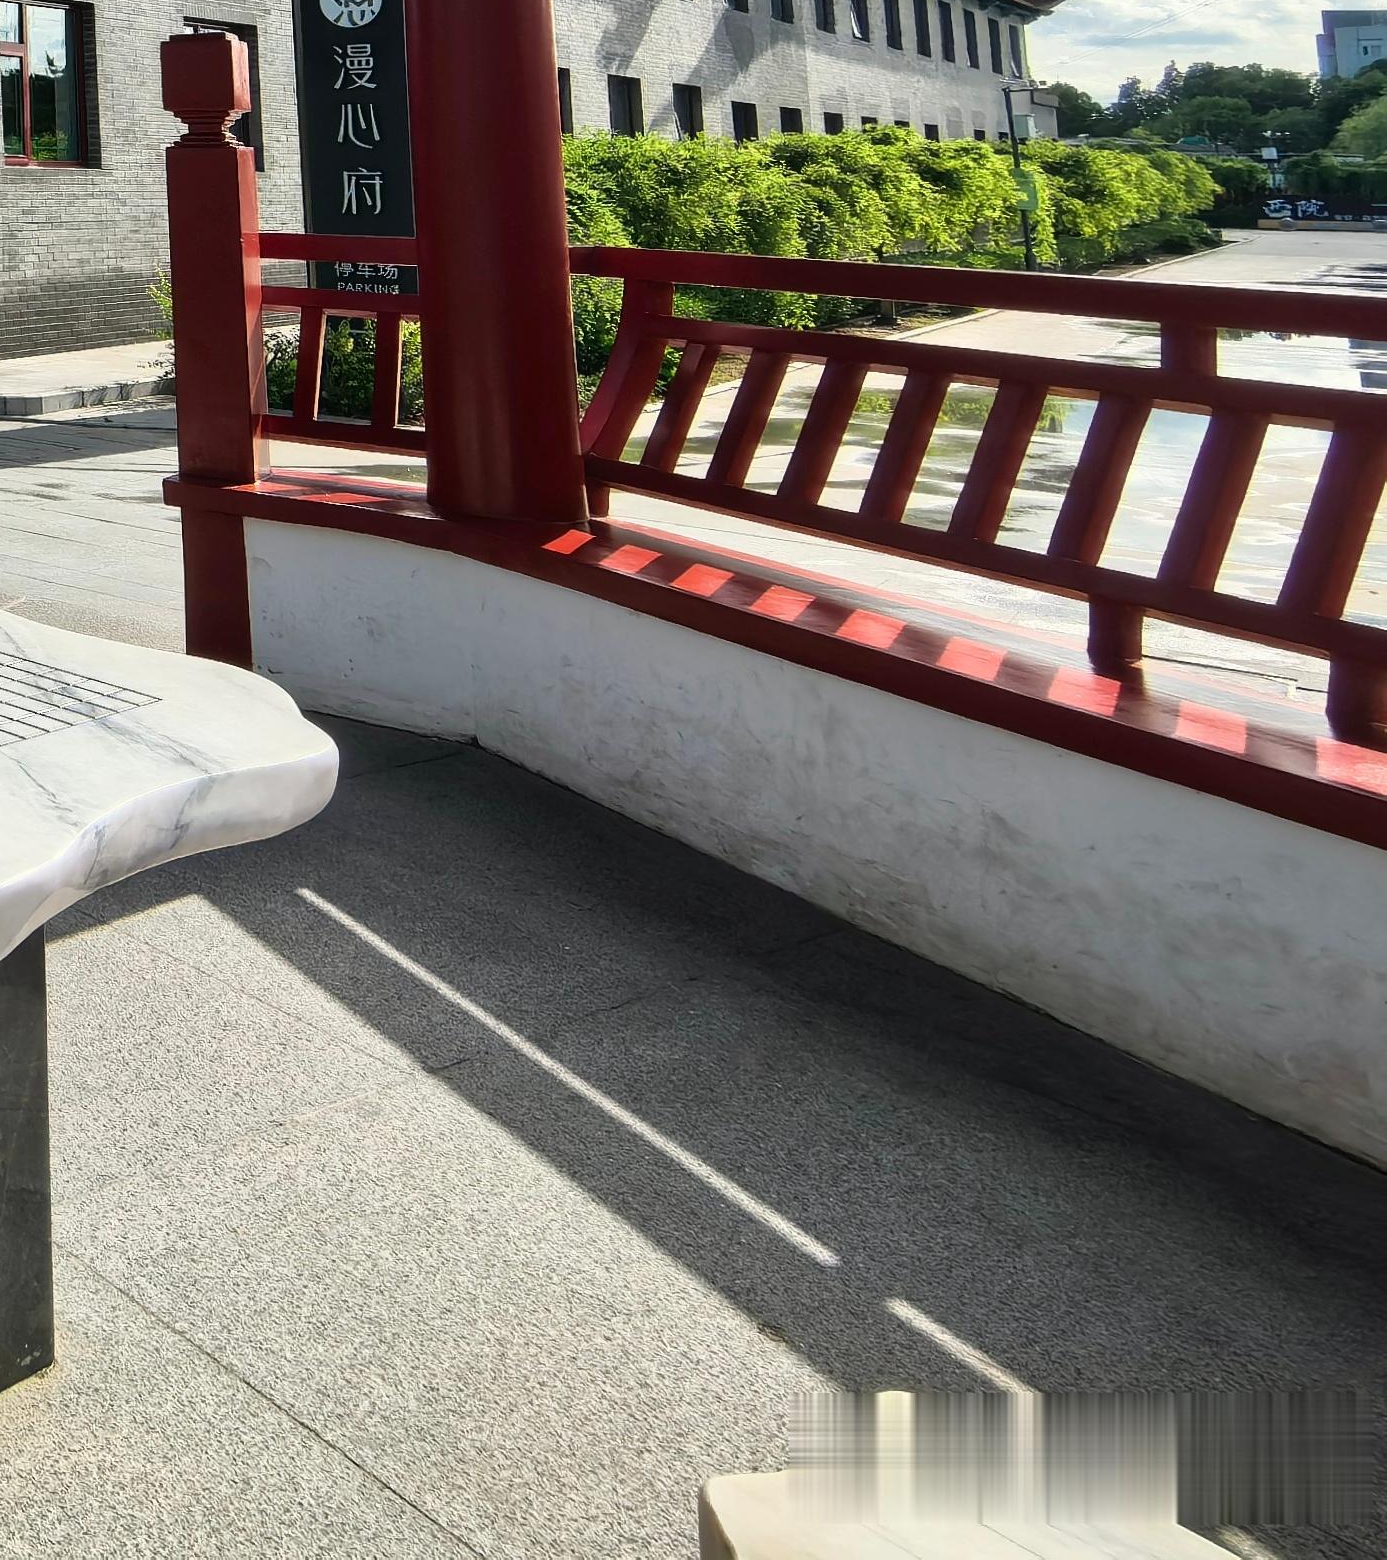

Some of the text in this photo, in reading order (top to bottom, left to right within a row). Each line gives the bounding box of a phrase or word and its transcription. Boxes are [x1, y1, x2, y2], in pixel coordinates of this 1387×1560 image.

[332, 43, 384, 216] 漫心府
[333, 261, 398, 280] 停车场
[337, 282, 400, 295] PARKING
